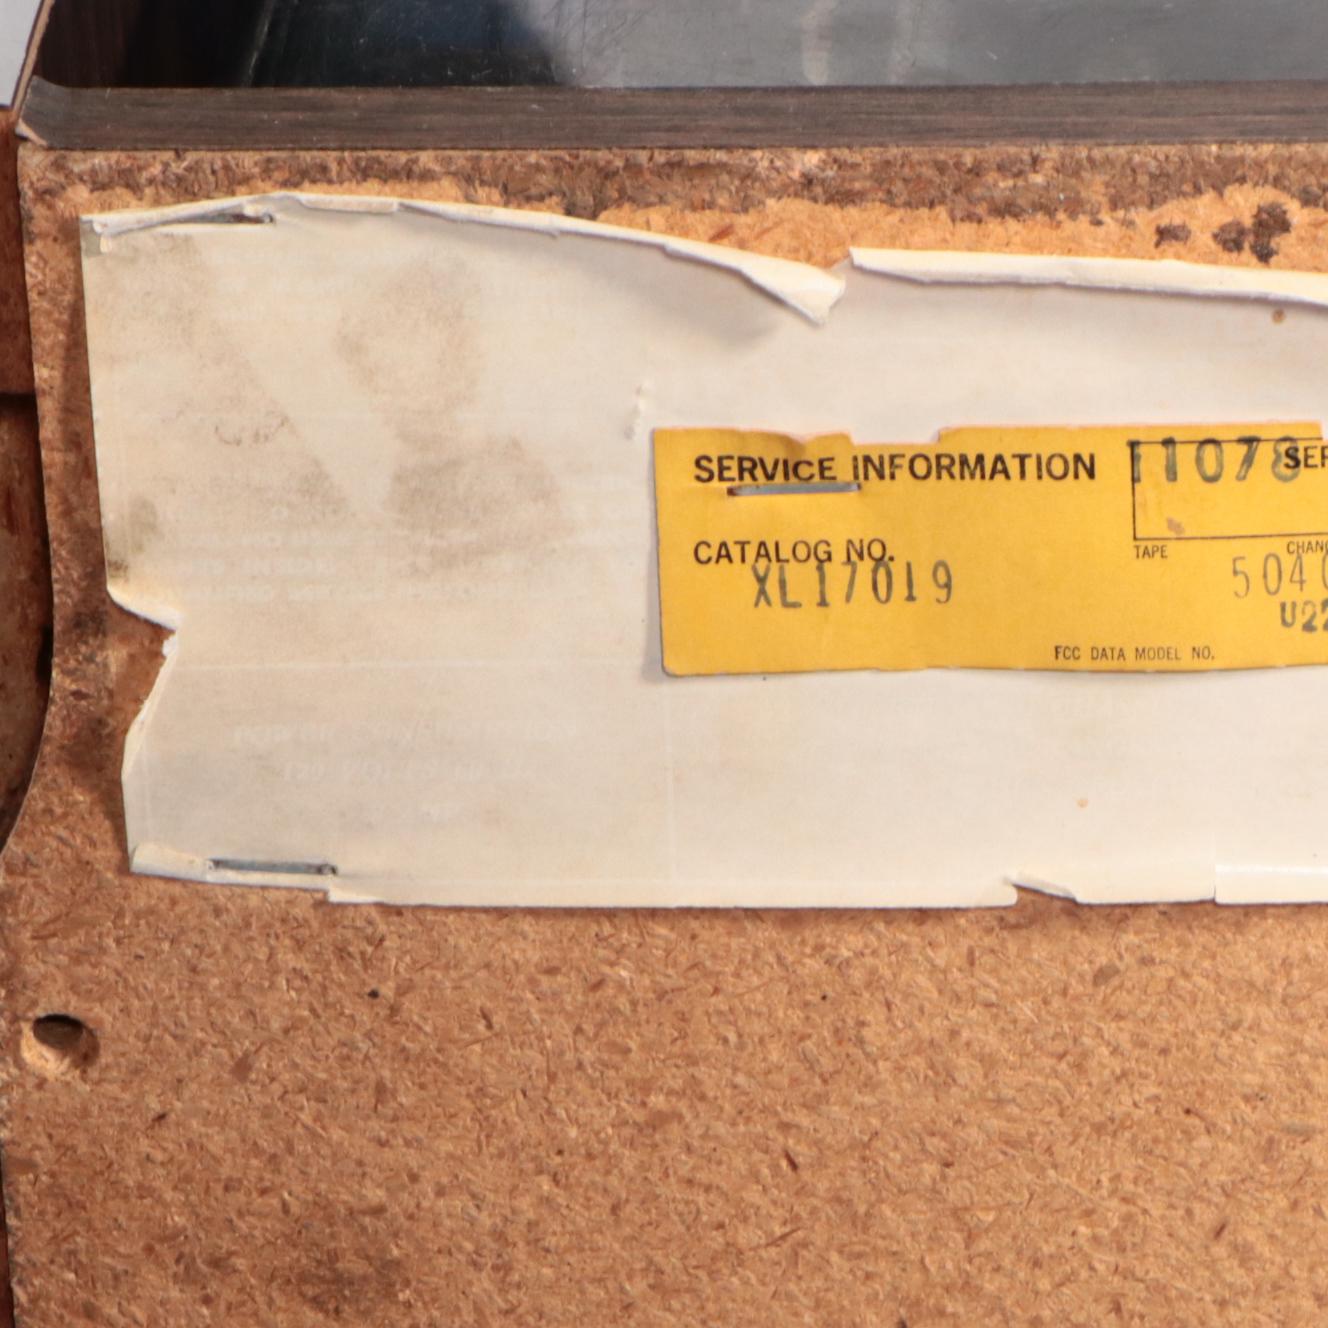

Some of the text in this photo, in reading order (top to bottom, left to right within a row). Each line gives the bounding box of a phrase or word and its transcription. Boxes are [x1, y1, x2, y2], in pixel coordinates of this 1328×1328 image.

[693, 452, 1097, 483] SERVICE INFORMATION
[693, 538, 896, 565] CATALOG NO.
[1133, 545, 1169, 560] TAPE
[750, 559, 954, 609] XL17019
[1054, 645, 1216, 661] FCC DATA MODEL NO.
